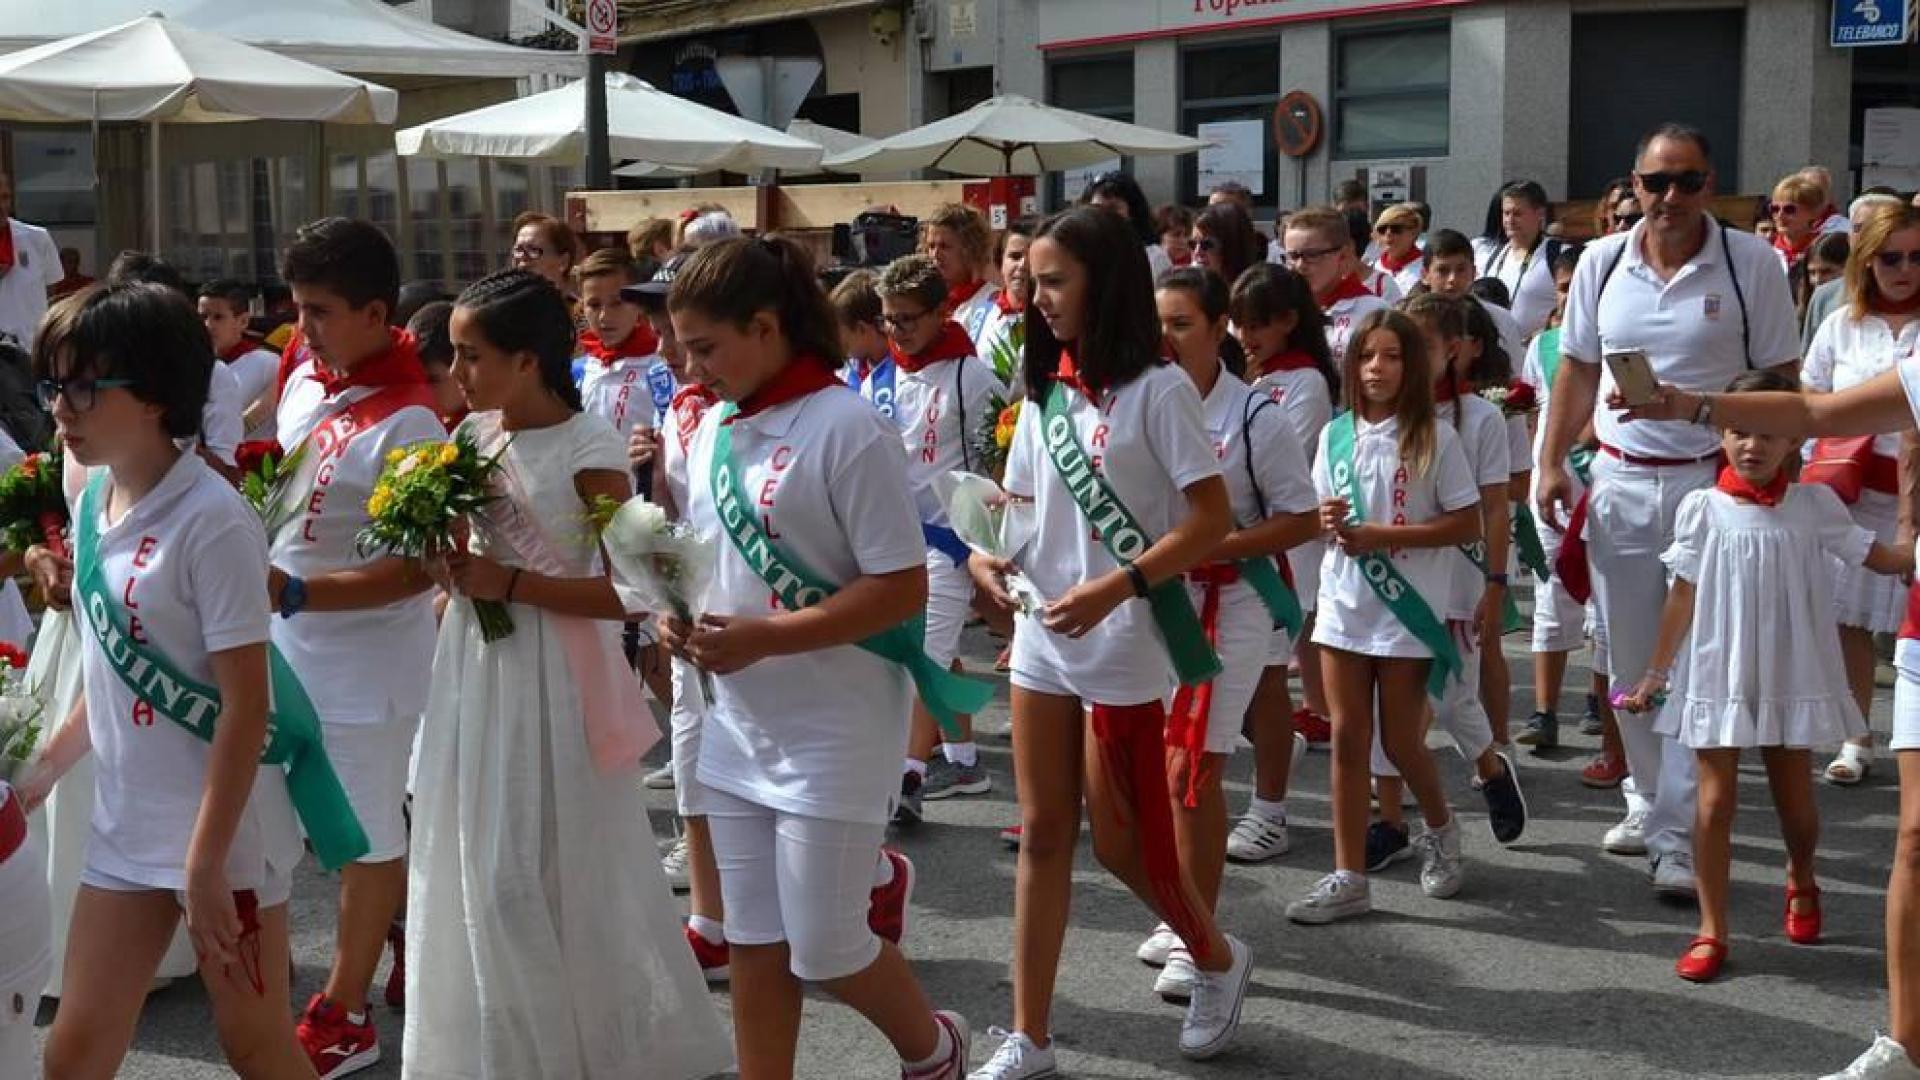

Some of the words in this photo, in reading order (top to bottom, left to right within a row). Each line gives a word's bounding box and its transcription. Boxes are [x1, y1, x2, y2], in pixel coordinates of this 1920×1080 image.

[1838, 24, 1899, 40] TELEBANCO
[616, 369, 637, 431] DANI
[91, 591, 223, 728] QUINT
[124, 536, 157, 726] ELEA
